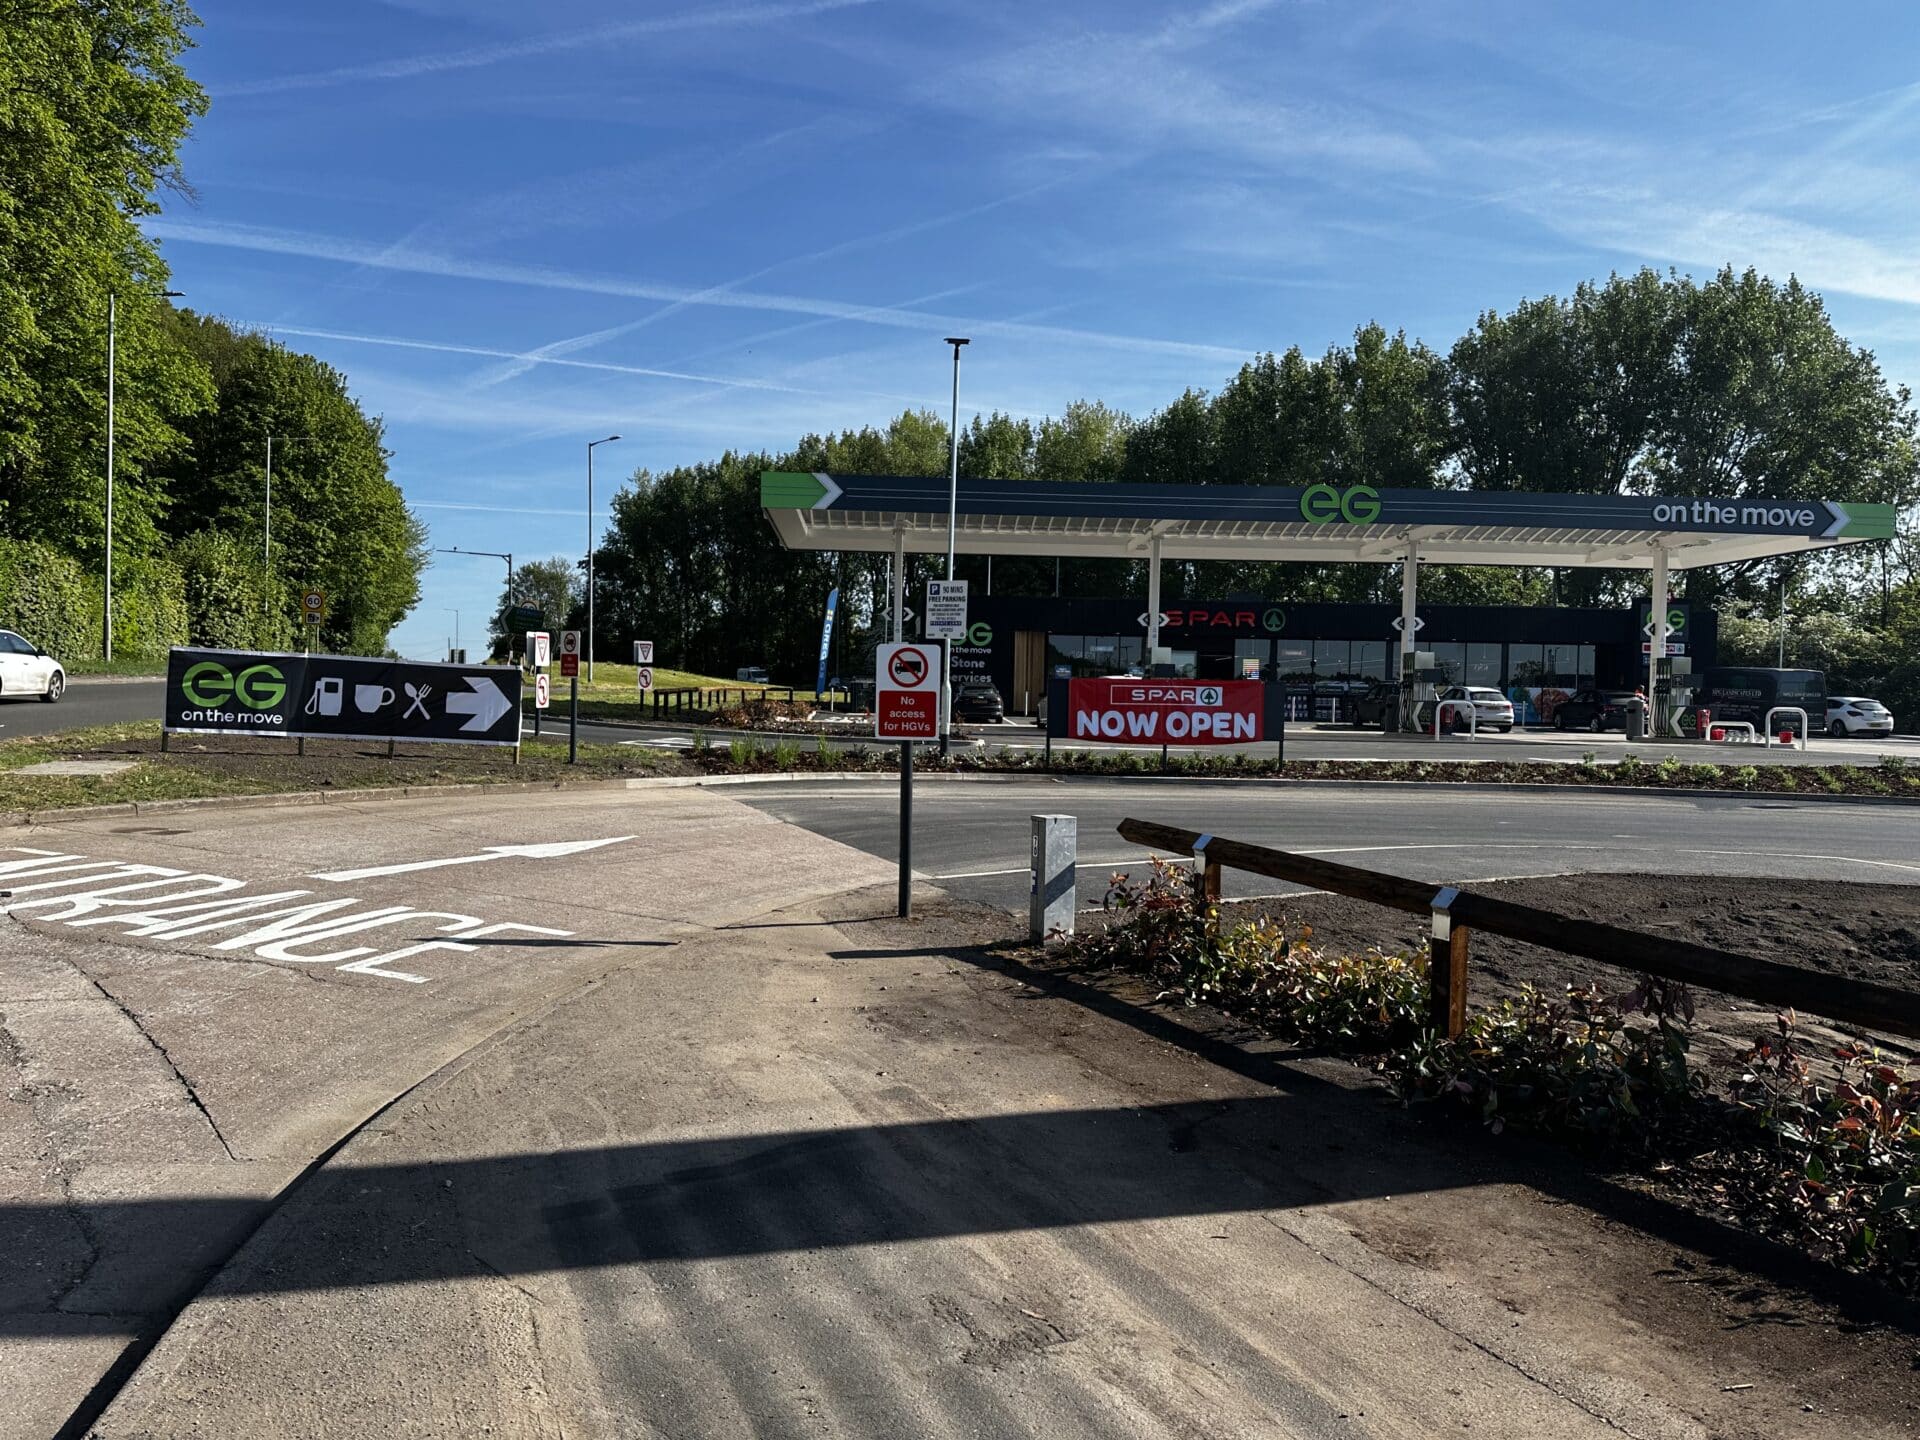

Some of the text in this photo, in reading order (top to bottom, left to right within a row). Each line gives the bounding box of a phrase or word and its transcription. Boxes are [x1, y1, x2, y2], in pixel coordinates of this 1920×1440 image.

[1653, 501, 1815, 526] on the move
[950, 586, 964, 594] MINS
[307, 597, 320, 605] 60
[1165, 611, 1256, 627] SPAR
[951, 656, 985, 668] Stone
[951, 671, 992, 682] ervices
[901, 696, 915, 705] No
[1131, 690, 1196, 702] SPAR
[181, 709, 283, 724] on the move
[884, 721, 930, 731] for HGVs
[1077, 710, 1256, 738] NOW OPEN
